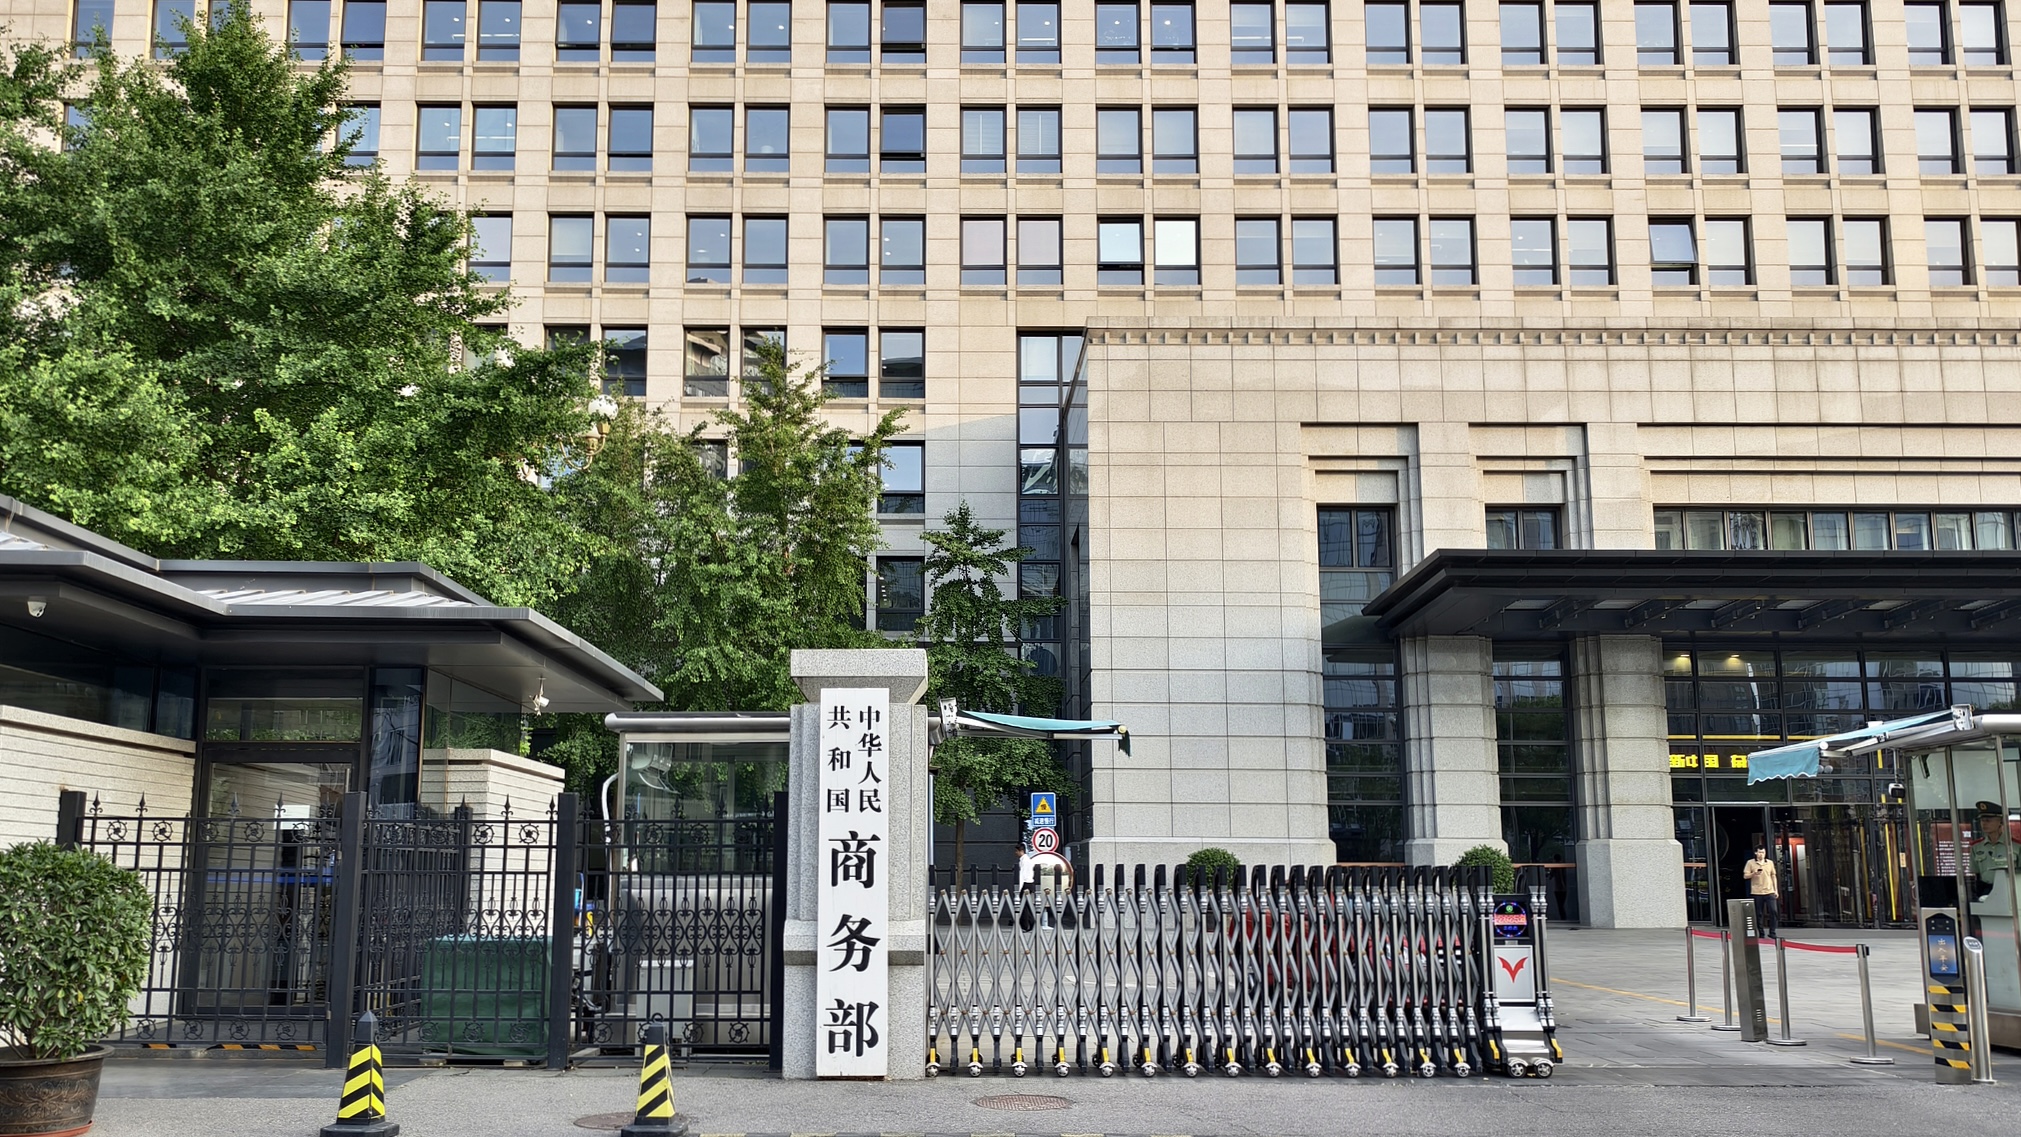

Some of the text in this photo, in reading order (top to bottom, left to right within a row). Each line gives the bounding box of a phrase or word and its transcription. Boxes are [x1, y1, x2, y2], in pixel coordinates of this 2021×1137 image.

[826, 705, 852, 813] 共和国
[859, 705, 882, 813] 中华人民
[1038, 833, 1053, 848] 20
[823, 830, 881, 1058] 商务部
[1937, 938, 1949, 972] 出入平安
